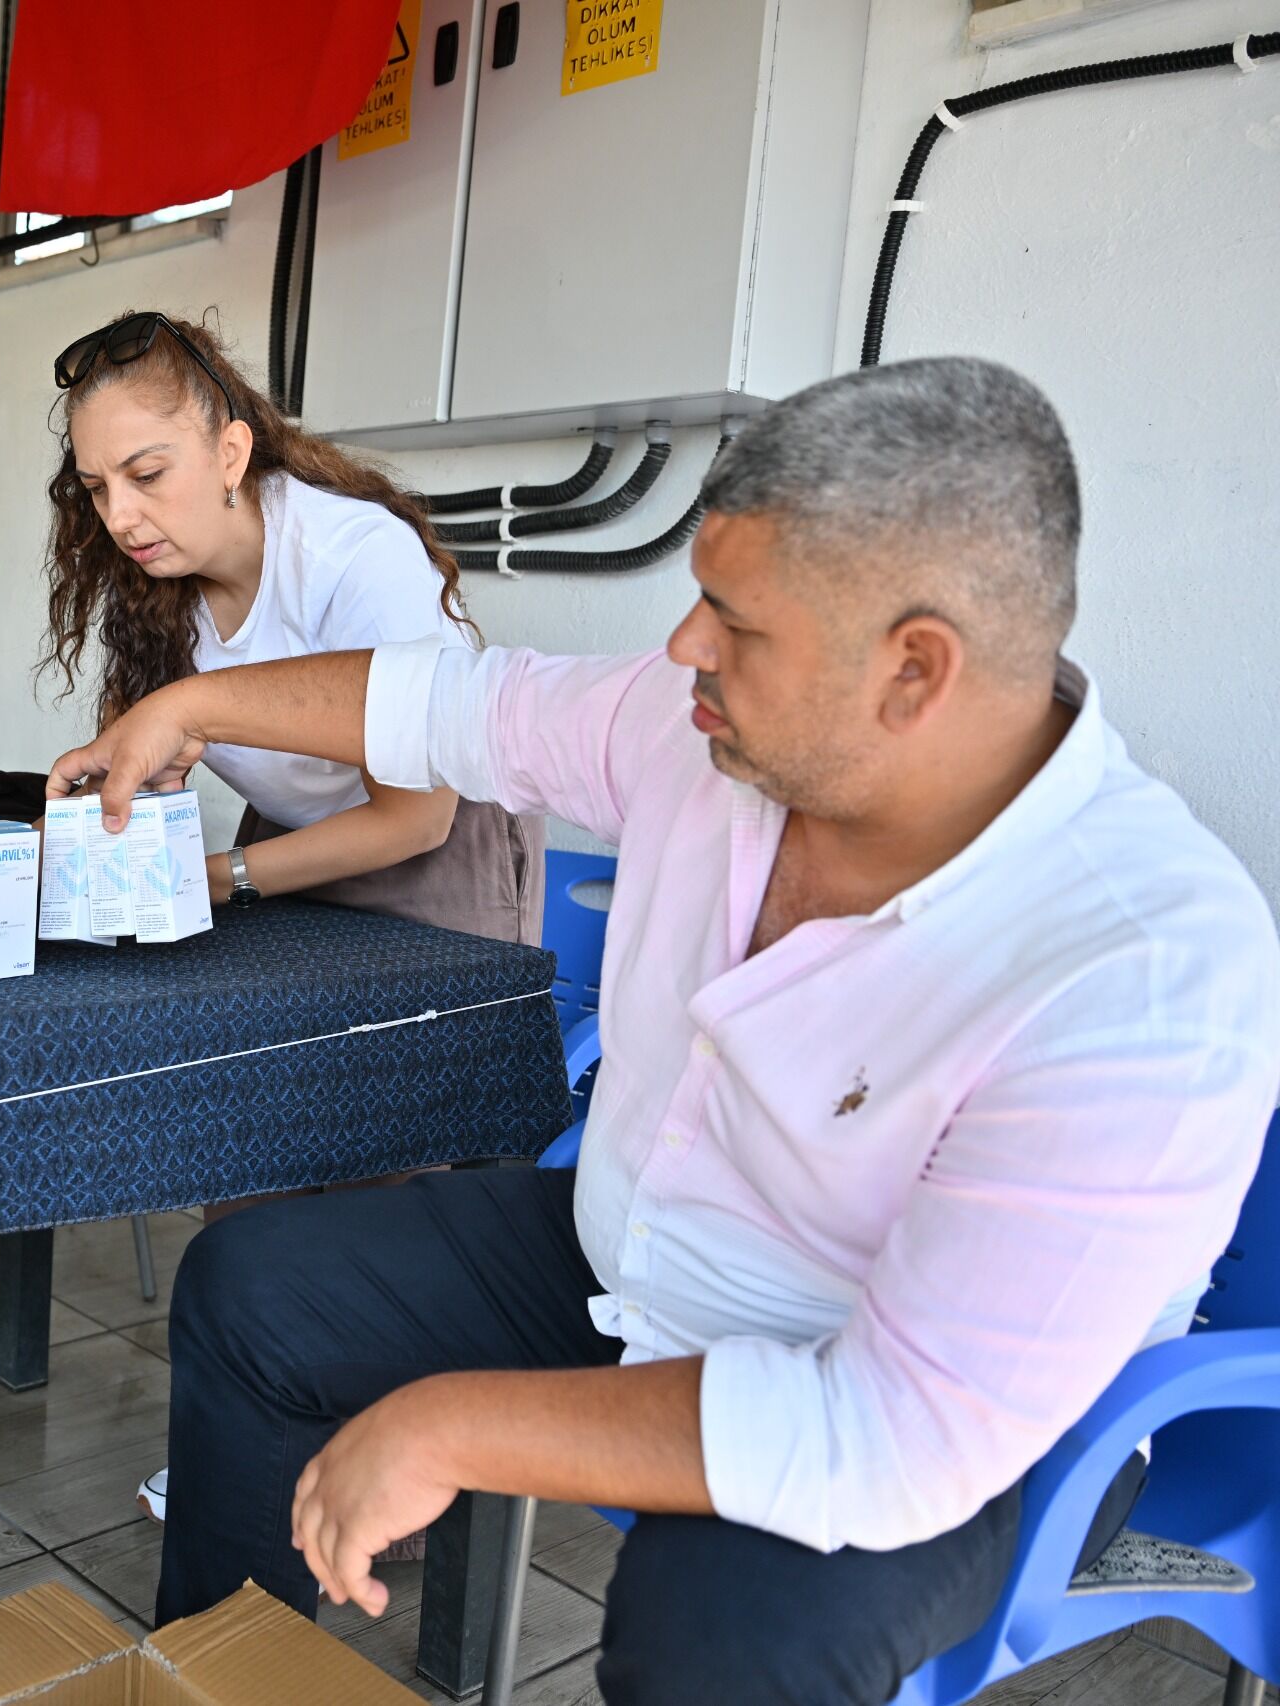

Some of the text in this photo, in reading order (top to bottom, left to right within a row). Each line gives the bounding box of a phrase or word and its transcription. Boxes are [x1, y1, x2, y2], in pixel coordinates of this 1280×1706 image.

[581, 0, 640, 24] DİKKA
[587, 15, 636, 45] ÖLÜM
[571, 28, 654, 74] TEHLİKESİ
